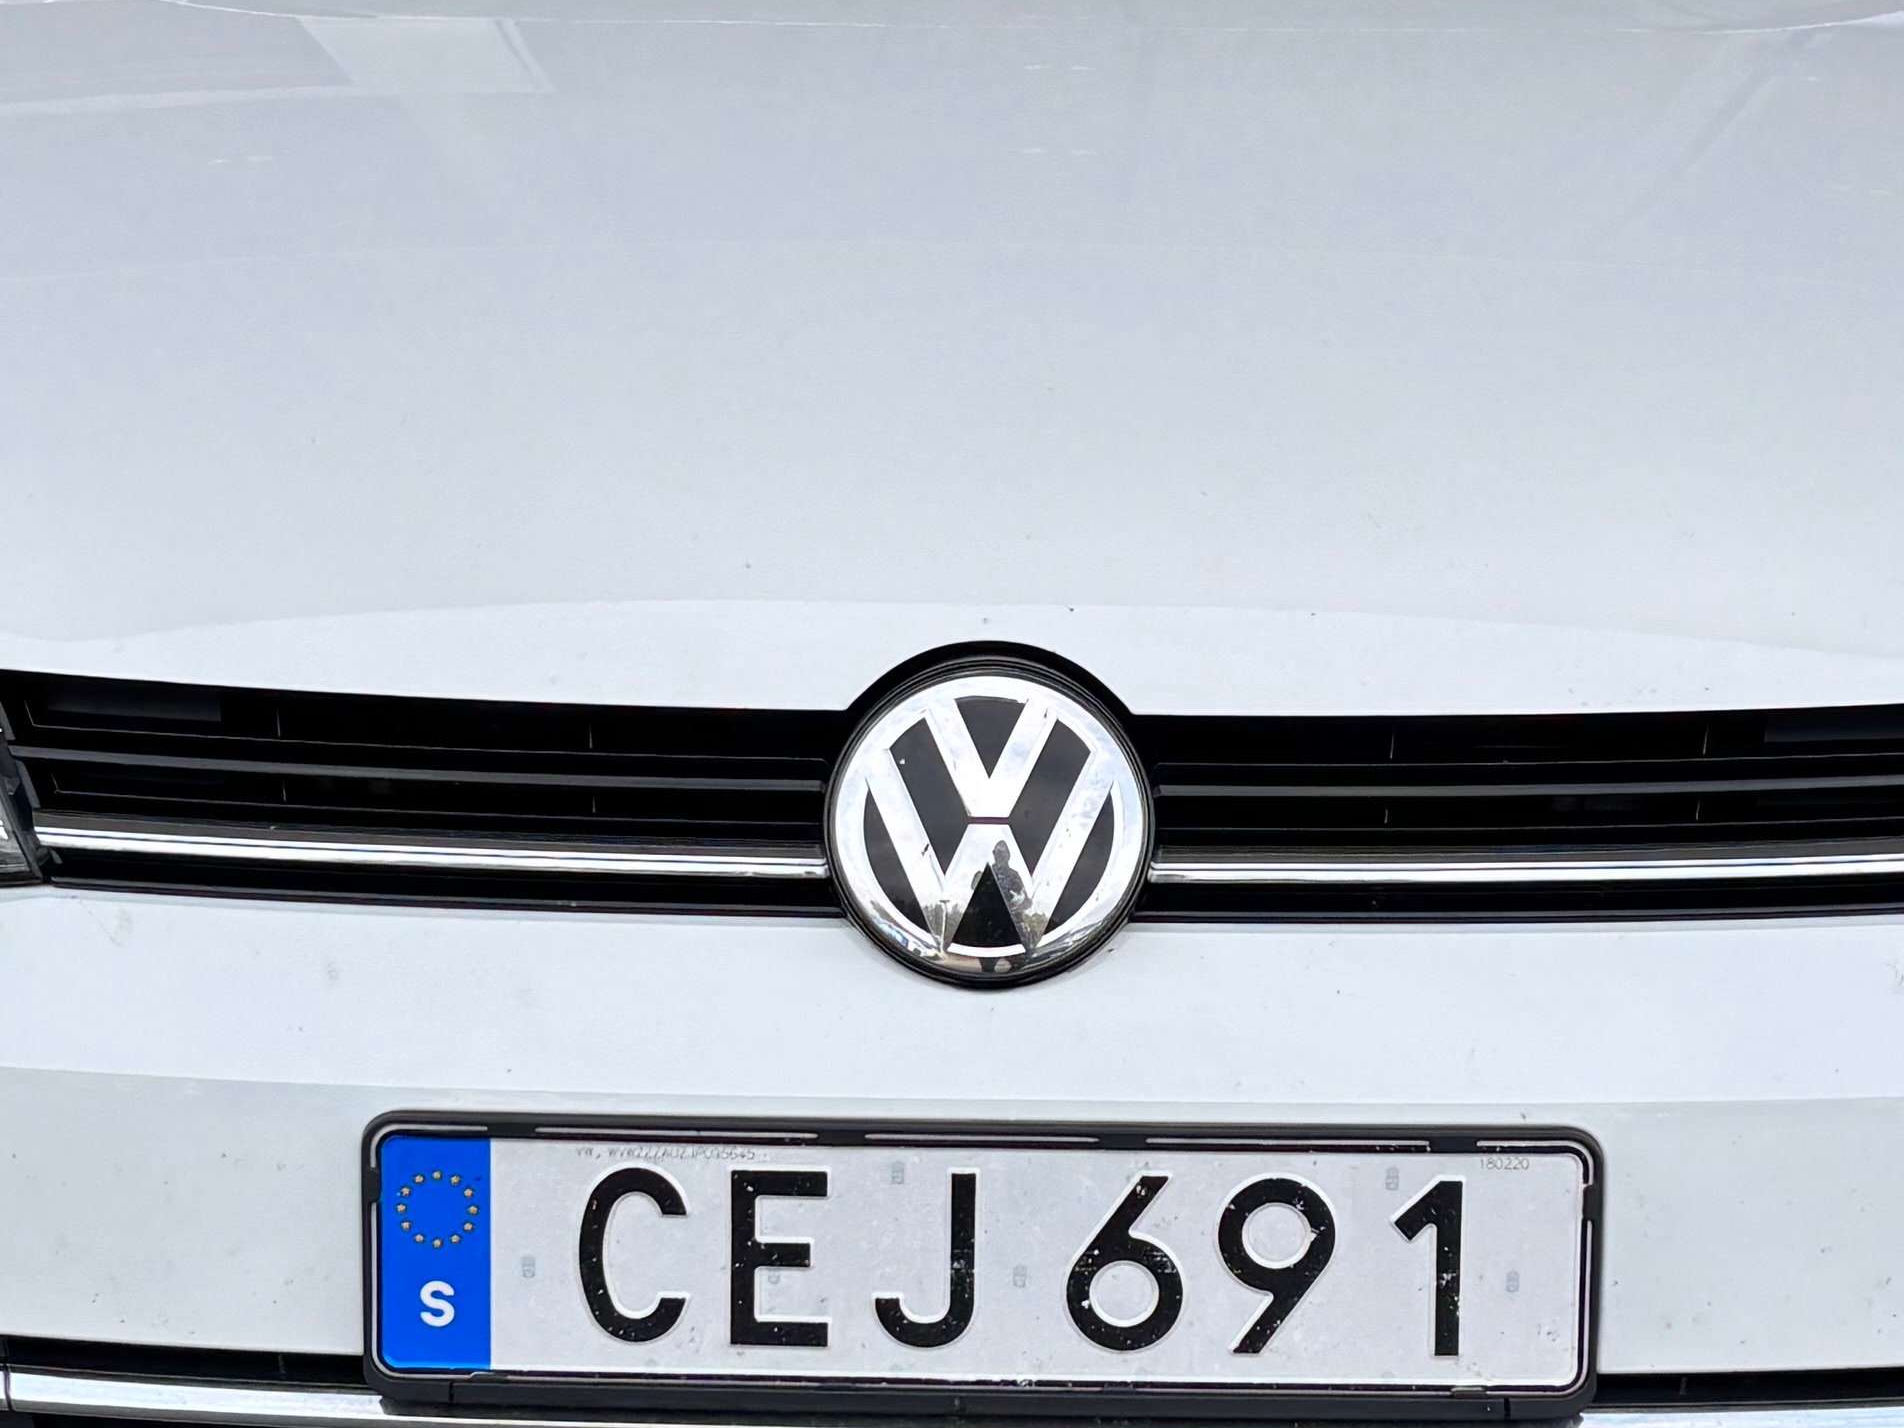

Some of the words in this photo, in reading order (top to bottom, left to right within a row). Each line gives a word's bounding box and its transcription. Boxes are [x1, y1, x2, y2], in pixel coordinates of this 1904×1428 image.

[1480, 1157, 1530, 1170] 180220
[577, 1167, 977, 1347] CEJ
[1065, 1175, 1459, 1357] 691
[419, 1280, 456, 1327] S
